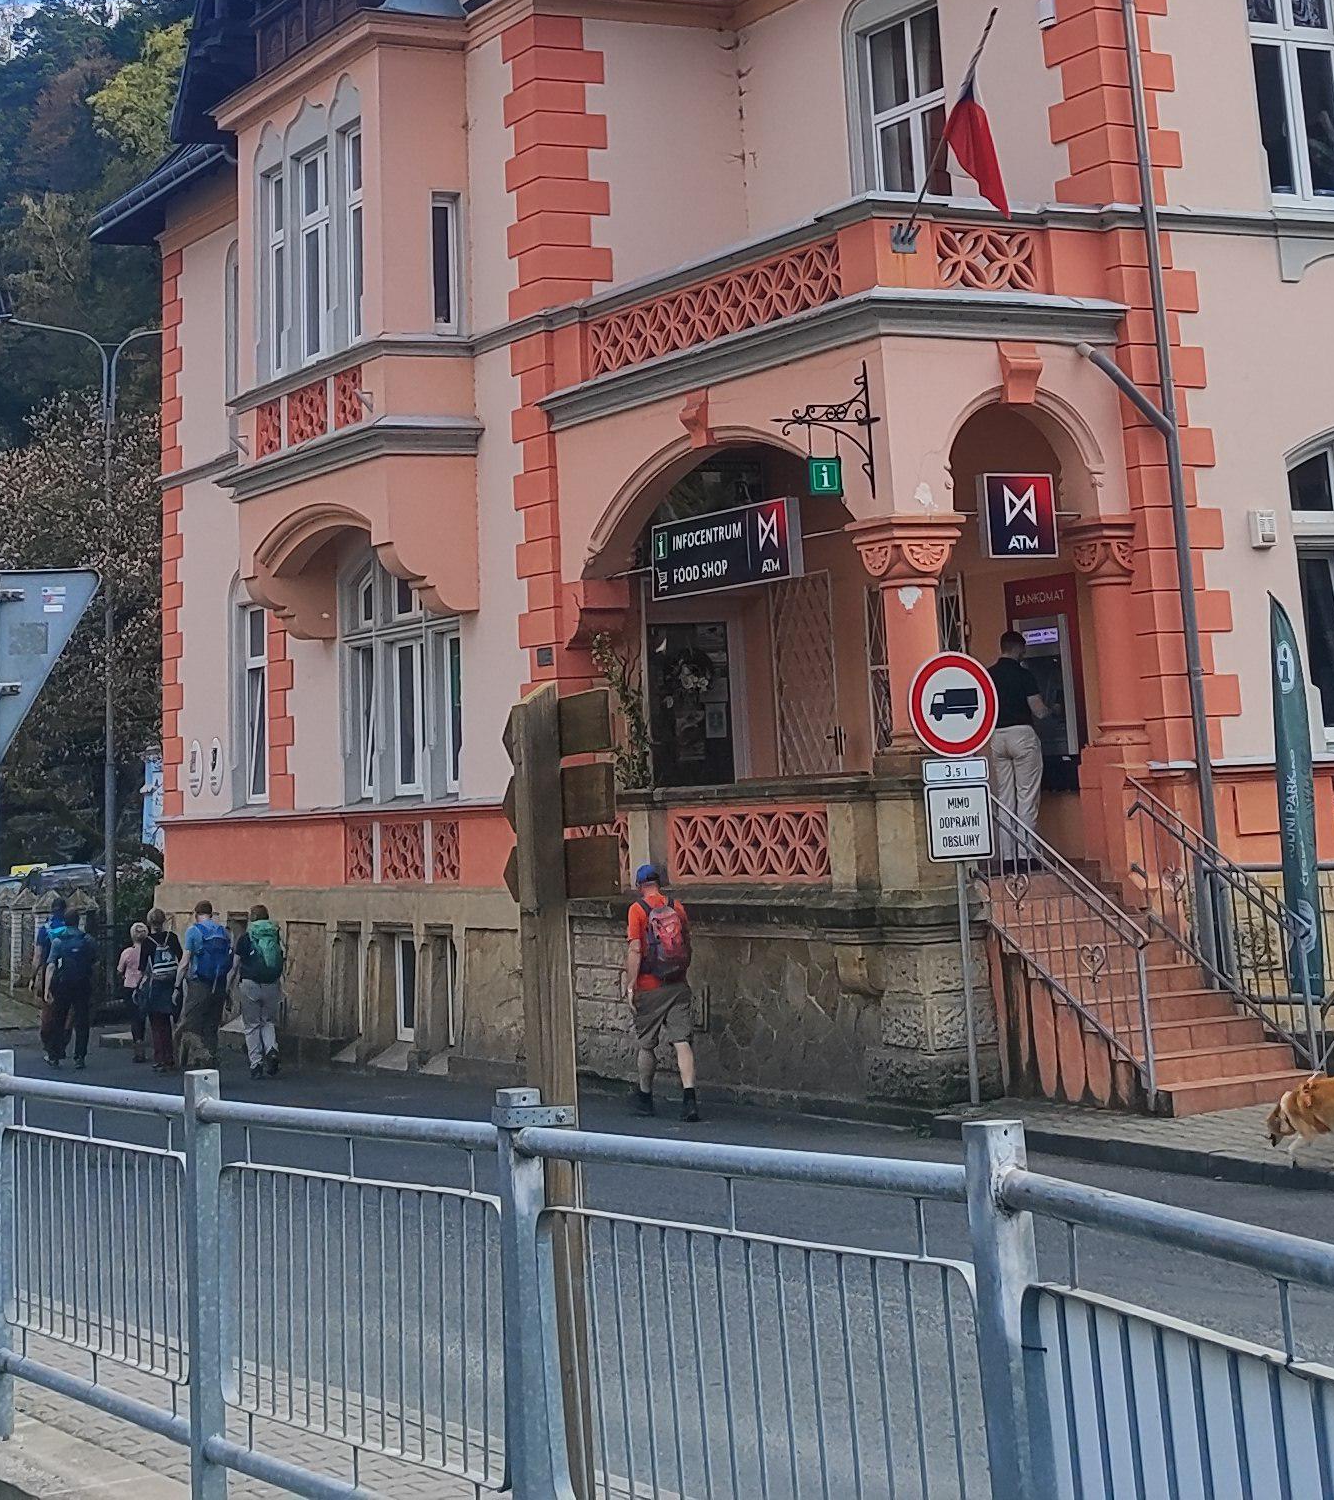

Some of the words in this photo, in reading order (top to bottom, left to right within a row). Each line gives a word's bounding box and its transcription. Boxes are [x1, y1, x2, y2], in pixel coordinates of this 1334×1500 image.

[672, 521, 742, 551] INFOCENTRUM
[1007, 534, 1039, 550] ATM
[673, 565, 700, 584] FOOD
[701, 559, 728, 580] SHOP
[761, 558, 781, 574] ATM
[1015, 589, 1065, 606] BANKOMAT
[947, 797, 970, 809] MIMO
